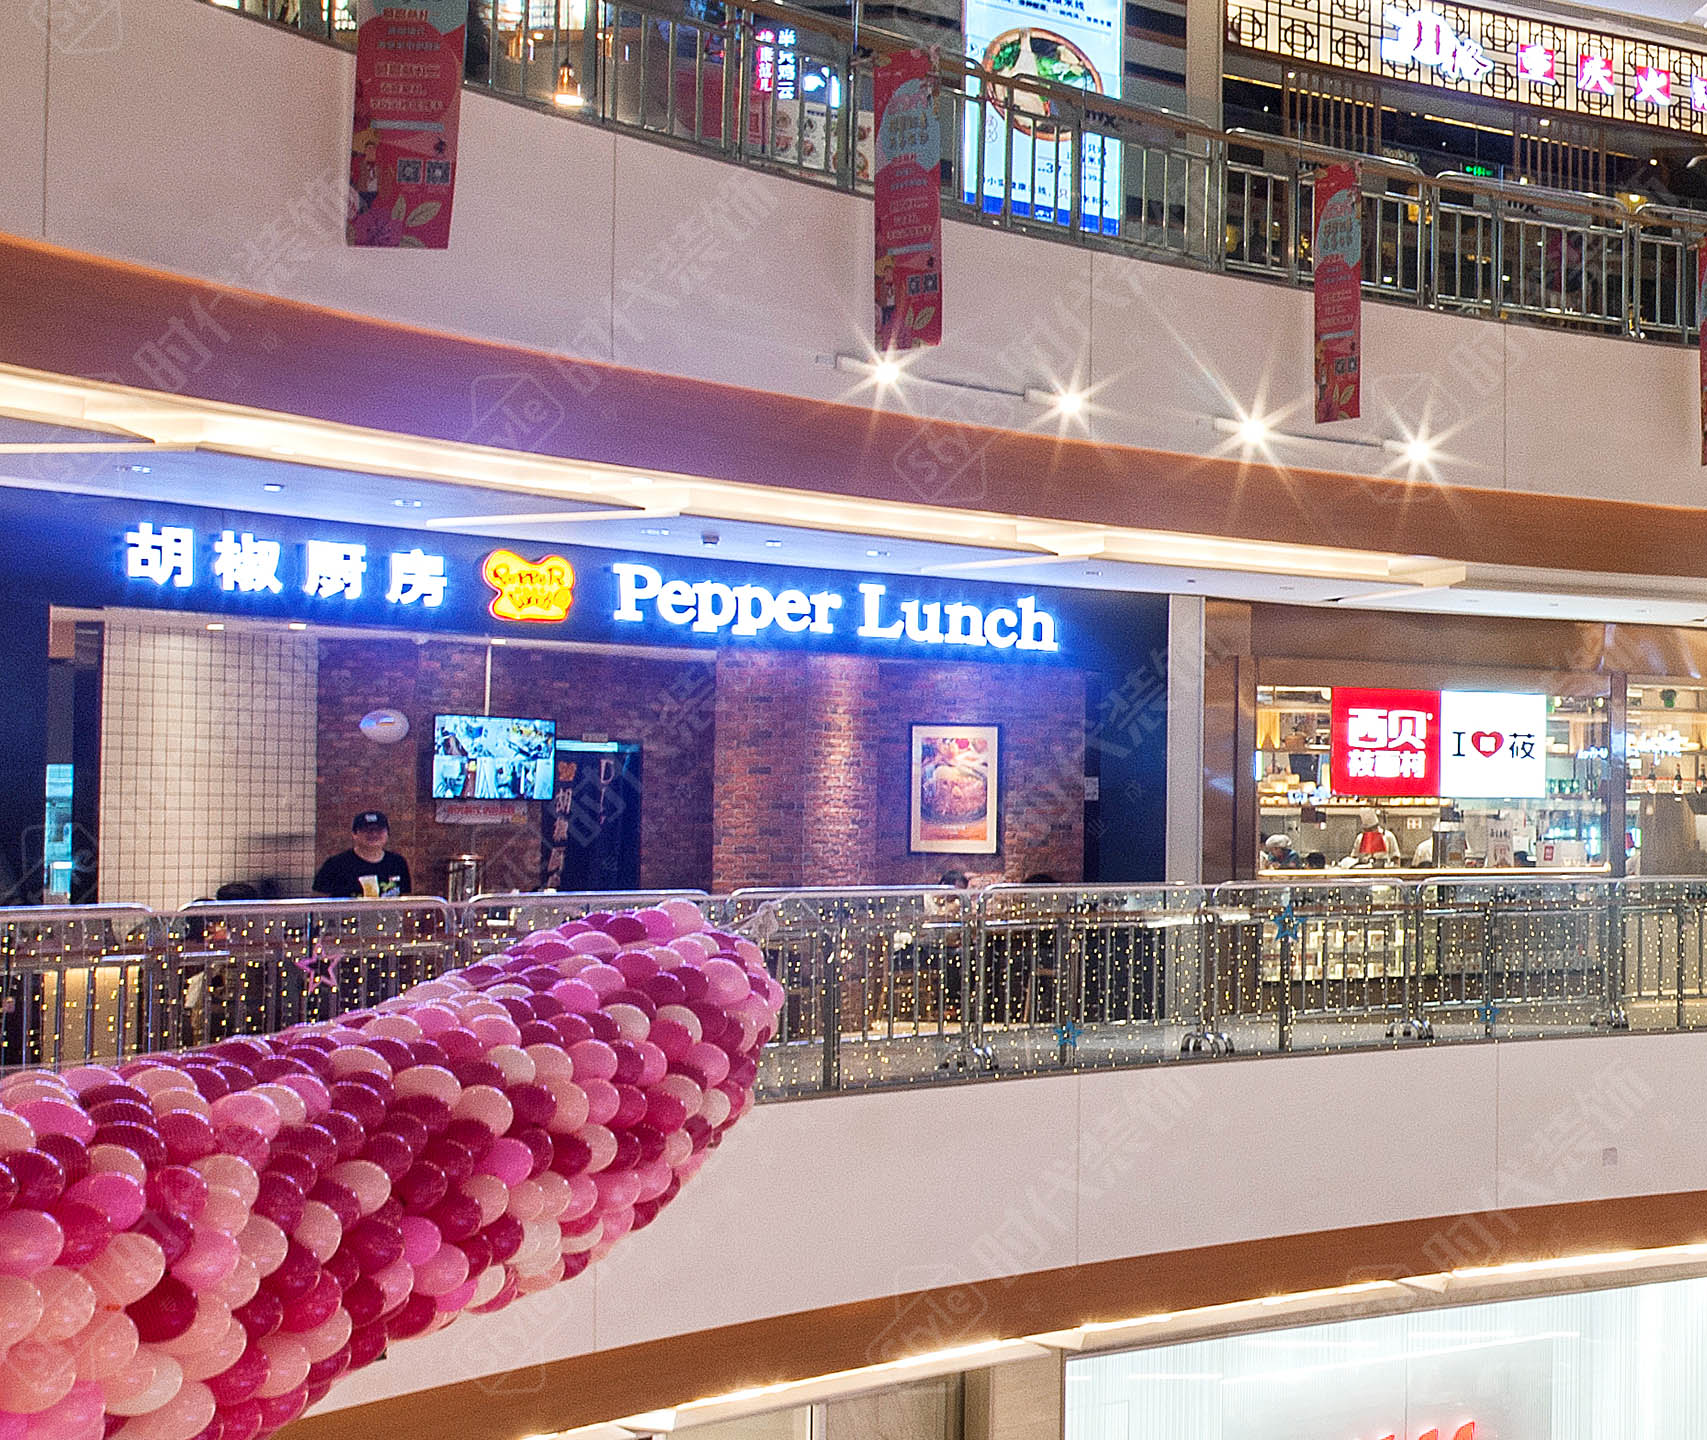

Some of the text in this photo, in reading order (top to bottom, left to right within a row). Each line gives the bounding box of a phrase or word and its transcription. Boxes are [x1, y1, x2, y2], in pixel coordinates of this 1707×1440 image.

[124, 521, 448, 608] 胡椒厨房
[611, 563, 1058, 652] Pepper Lunch
[1347, 708, 1429, 749] 西贝
[1508, 732, 1536, 760] 莜
